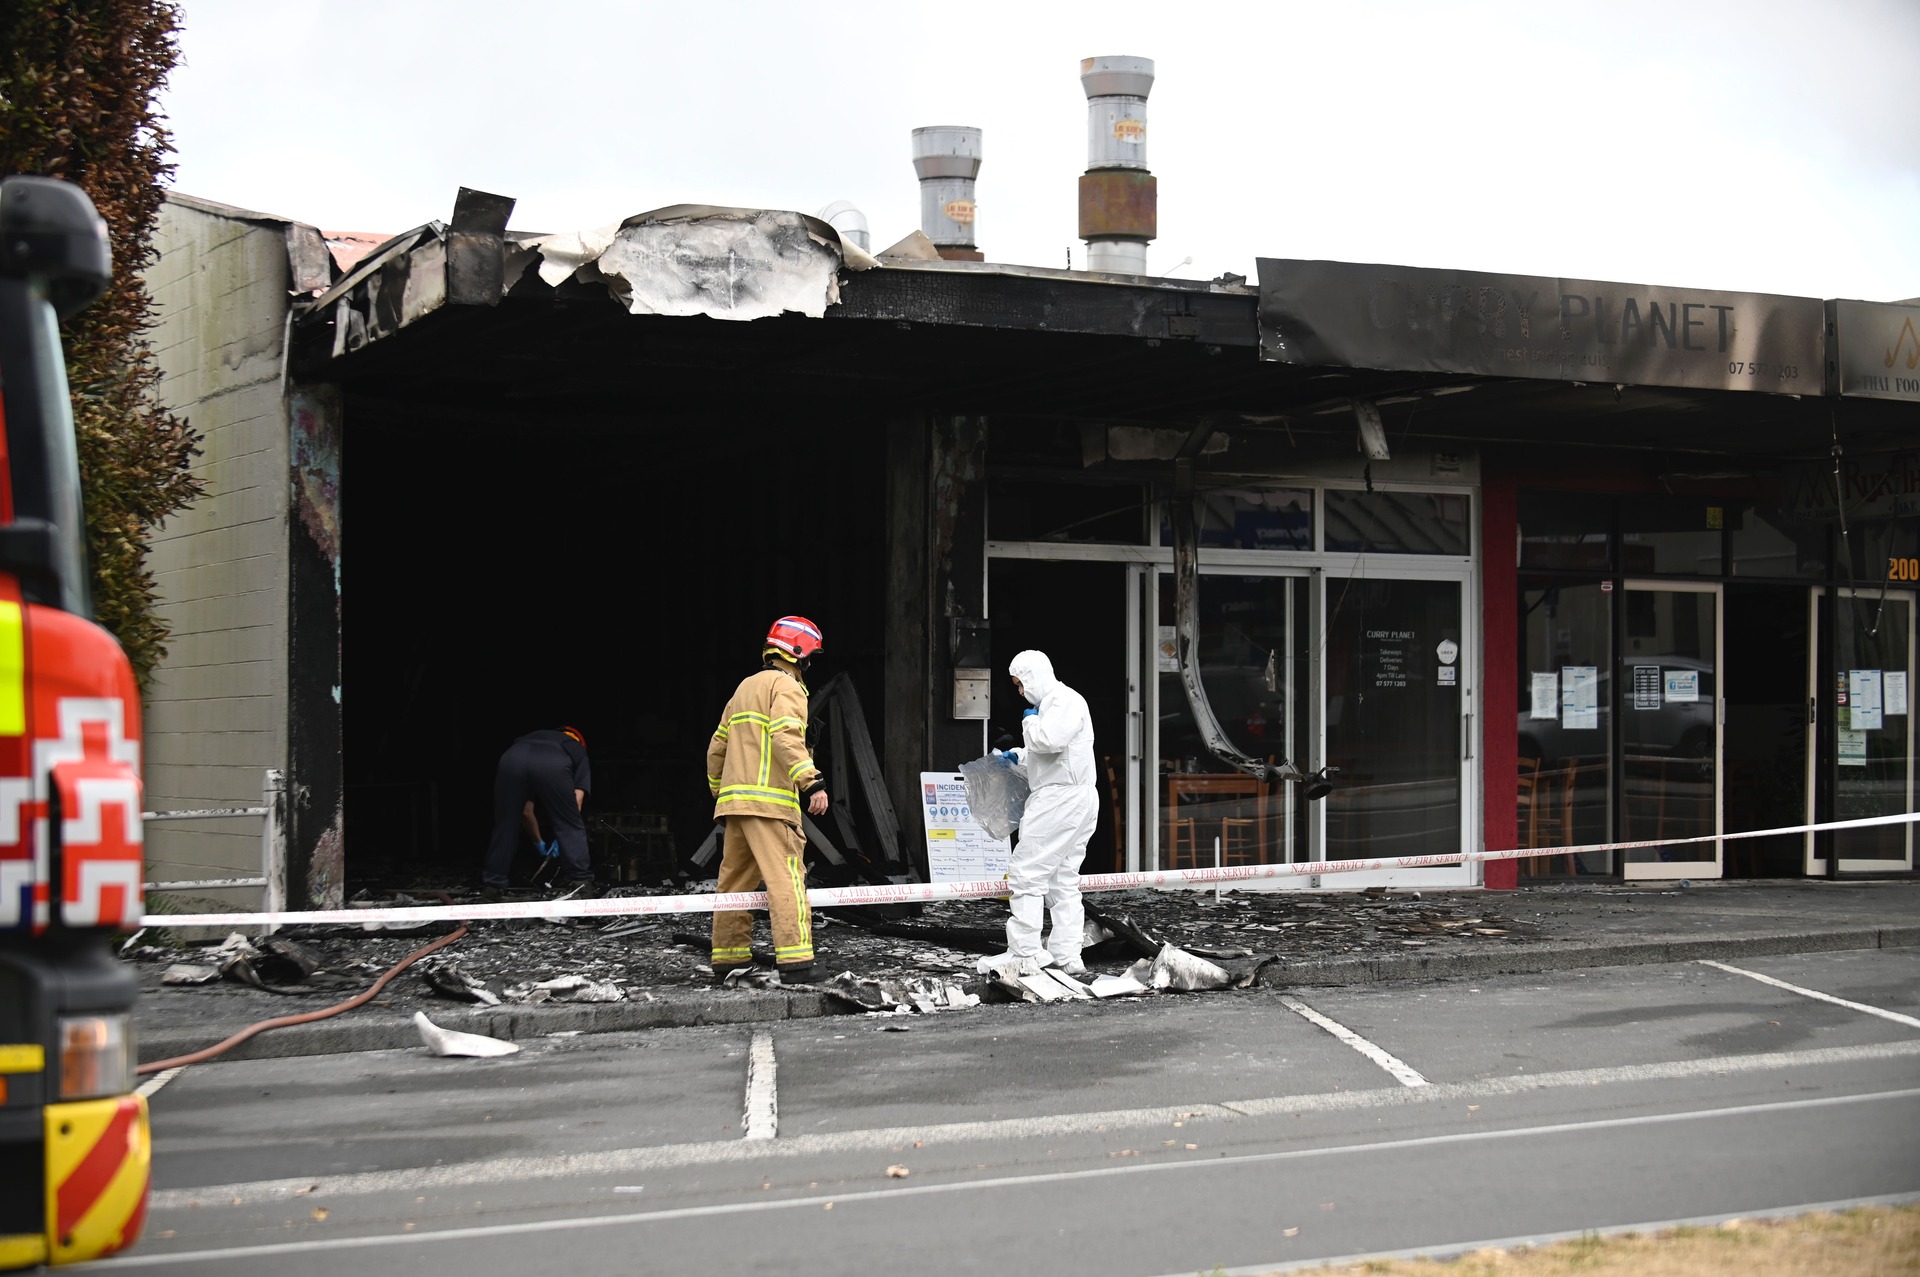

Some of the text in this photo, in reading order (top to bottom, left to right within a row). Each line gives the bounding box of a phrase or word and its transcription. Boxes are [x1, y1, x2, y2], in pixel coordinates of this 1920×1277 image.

[1560, 294, 1734, 353] PLANET
[1729, 361, 1744, 375] 07
[1748, 363, 1769, 376] 577
[1862, 375, 1920, 393] THAI FOO
[1888, 557, 1920, 580] 200
[1366, 630, 1415, 639] CURRY PLANET
[1387, 664, 1399, 672] Days
[1516, 849, 1536, 857] FIRE
[1537, 847, 1570, 855] SERVICE
[1414, 856, 1433, 865] FIRE
[1435, 854, 1470, 864] SERVICE
[1181, 866, 1259, 880] N.Z. FIRE SERVICE
[1291, 864, 1308, 873] N.Z.
[1309, 862, 1330, 872] FIRE
[1330, 860, 1366, 871] SERVICE
[971, 881, 993, 891] FIRE
[1088, 875, 1110, 886] FIRE
[1110, 873, 1149, 885] SERVICE
[724, 893, 748, 902] FIRE
[849, 887, 873, 898] FIRE
[873, 885, 916, 897] SERVICE
